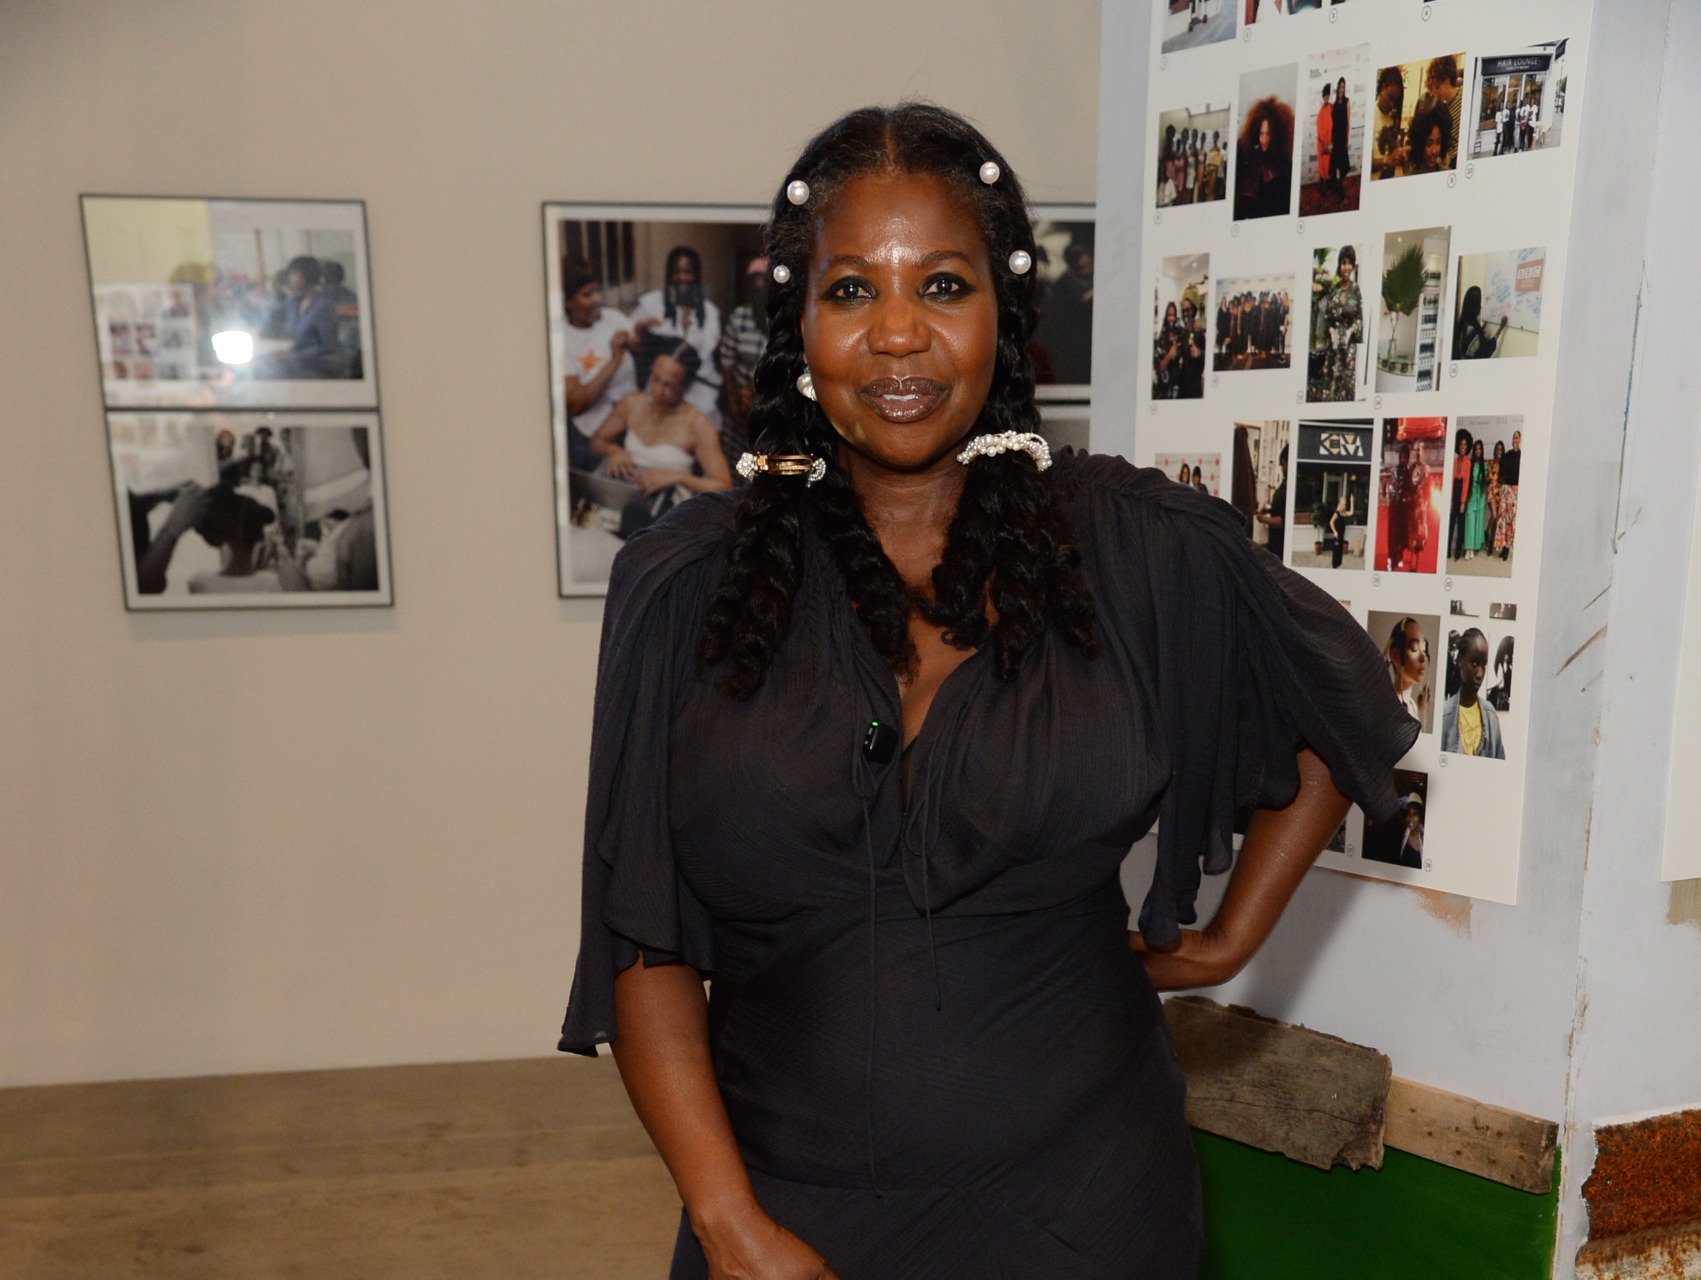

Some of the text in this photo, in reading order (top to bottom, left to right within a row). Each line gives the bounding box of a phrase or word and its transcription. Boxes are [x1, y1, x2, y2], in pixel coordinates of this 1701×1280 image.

[1497, 57, 1538, 67] HAIR LOUNGE
[1518, 265, 1541, 279] BBC
